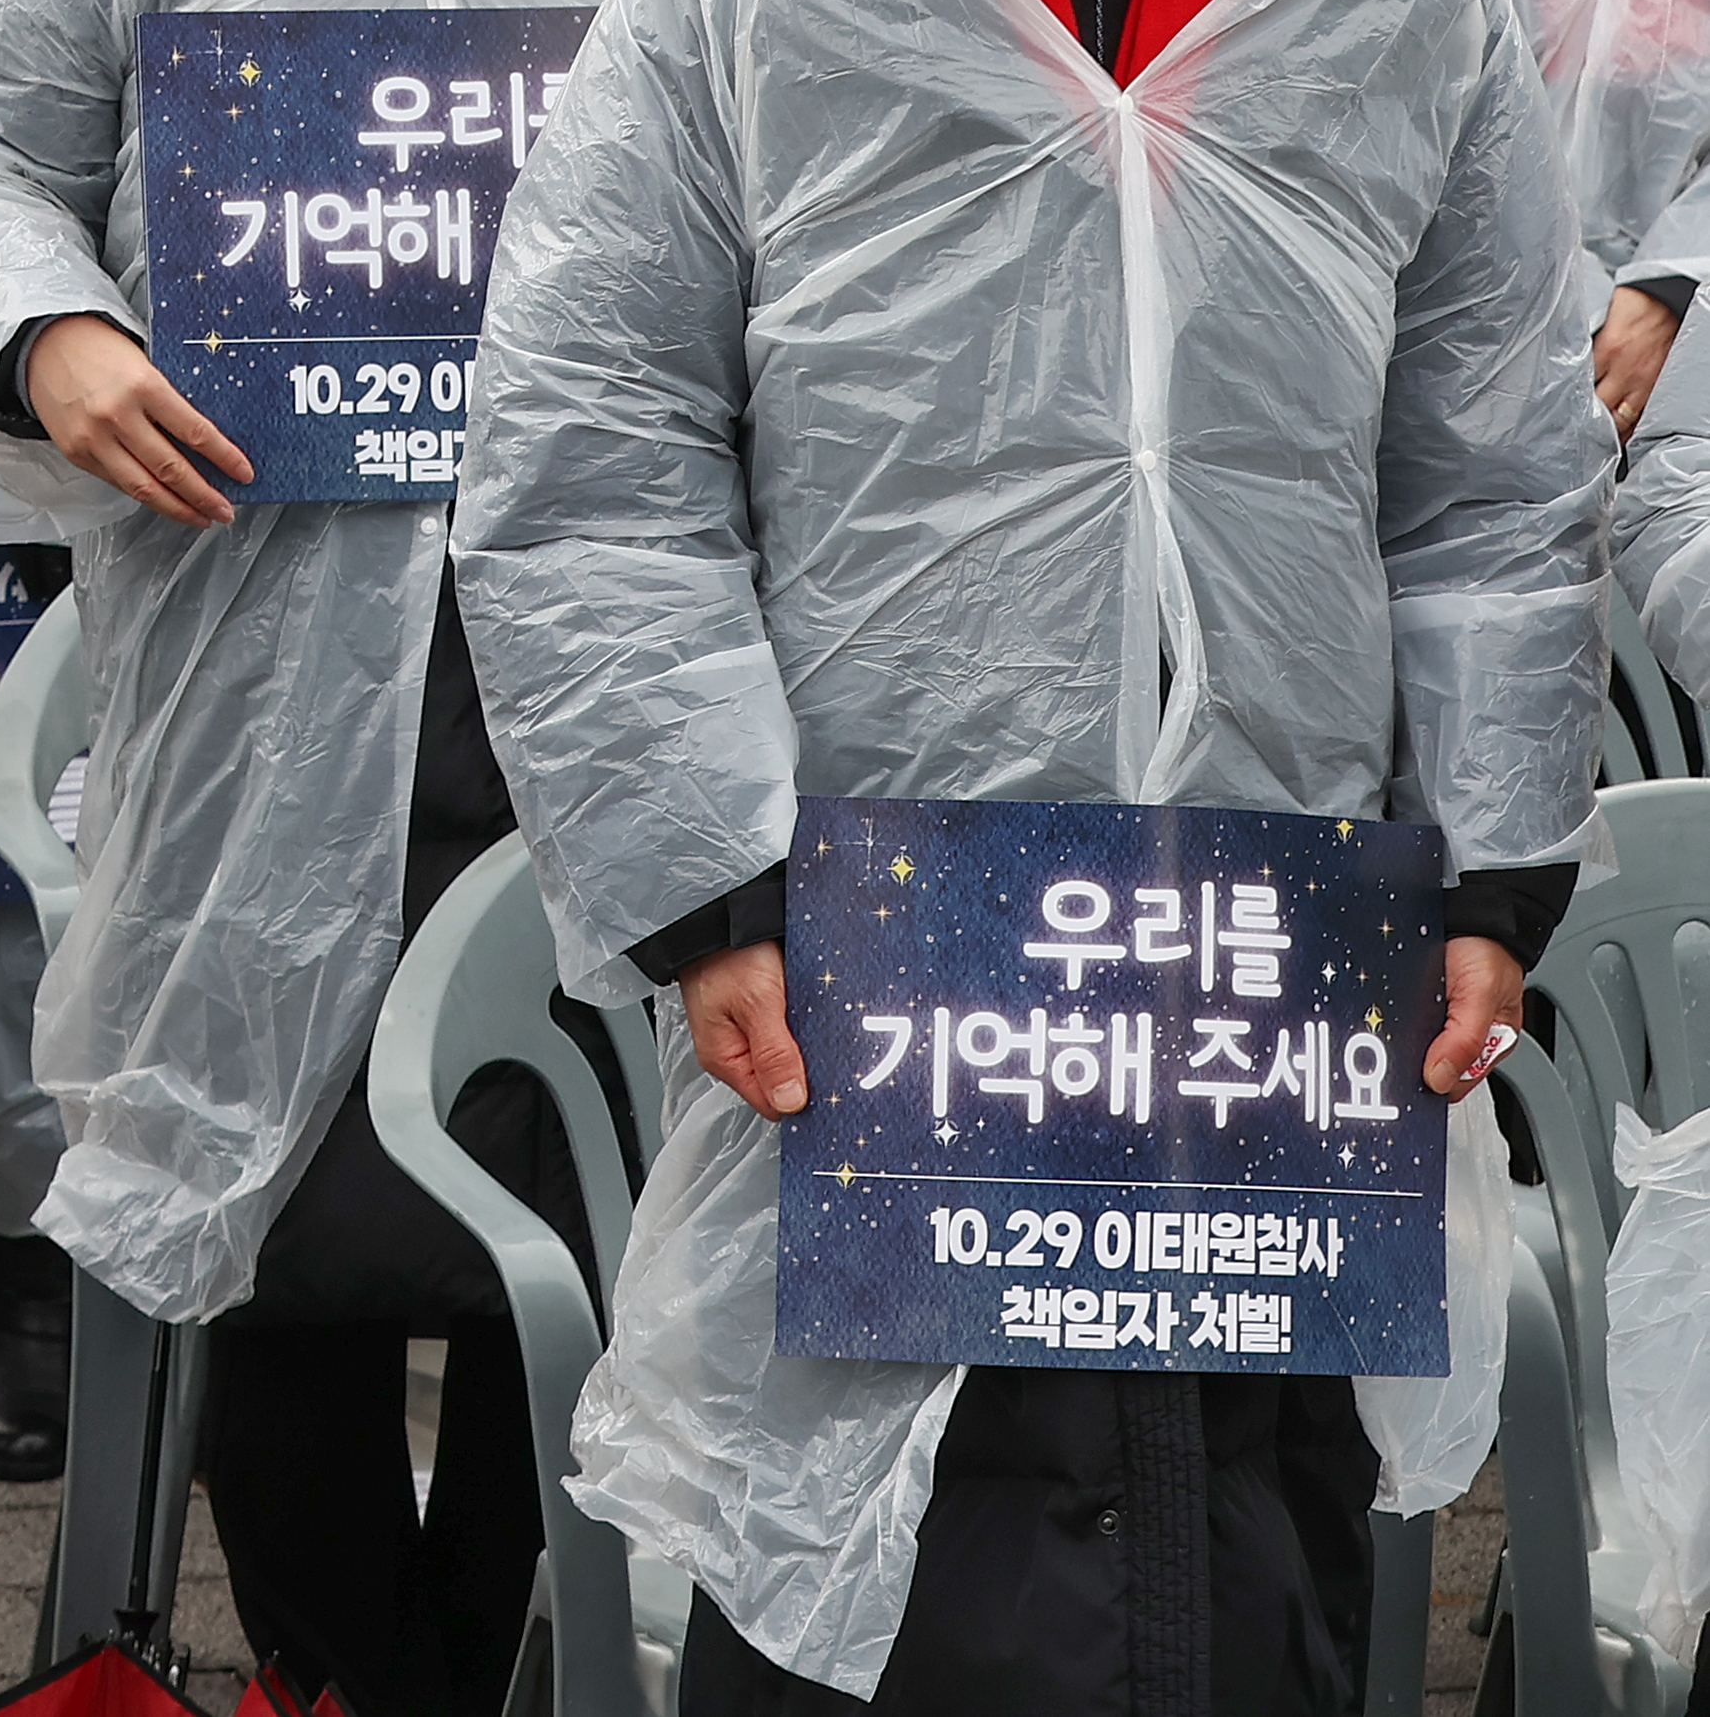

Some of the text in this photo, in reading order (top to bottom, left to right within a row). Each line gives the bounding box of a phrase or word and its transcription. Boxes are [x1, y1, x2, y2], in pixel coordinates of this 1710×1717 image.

[221, 188, 473, 289] 기억해
[289, 362, 421, 415] 10.29
[1023, 879, 1292, 998] 우리를
[859, 1006, 1400, 1131] 기억해 주세요
[930, 1207, 1344, 1278] 10.29 이태원참사
[1000, 1285, 1291, 1354] 책임자 처벌!
